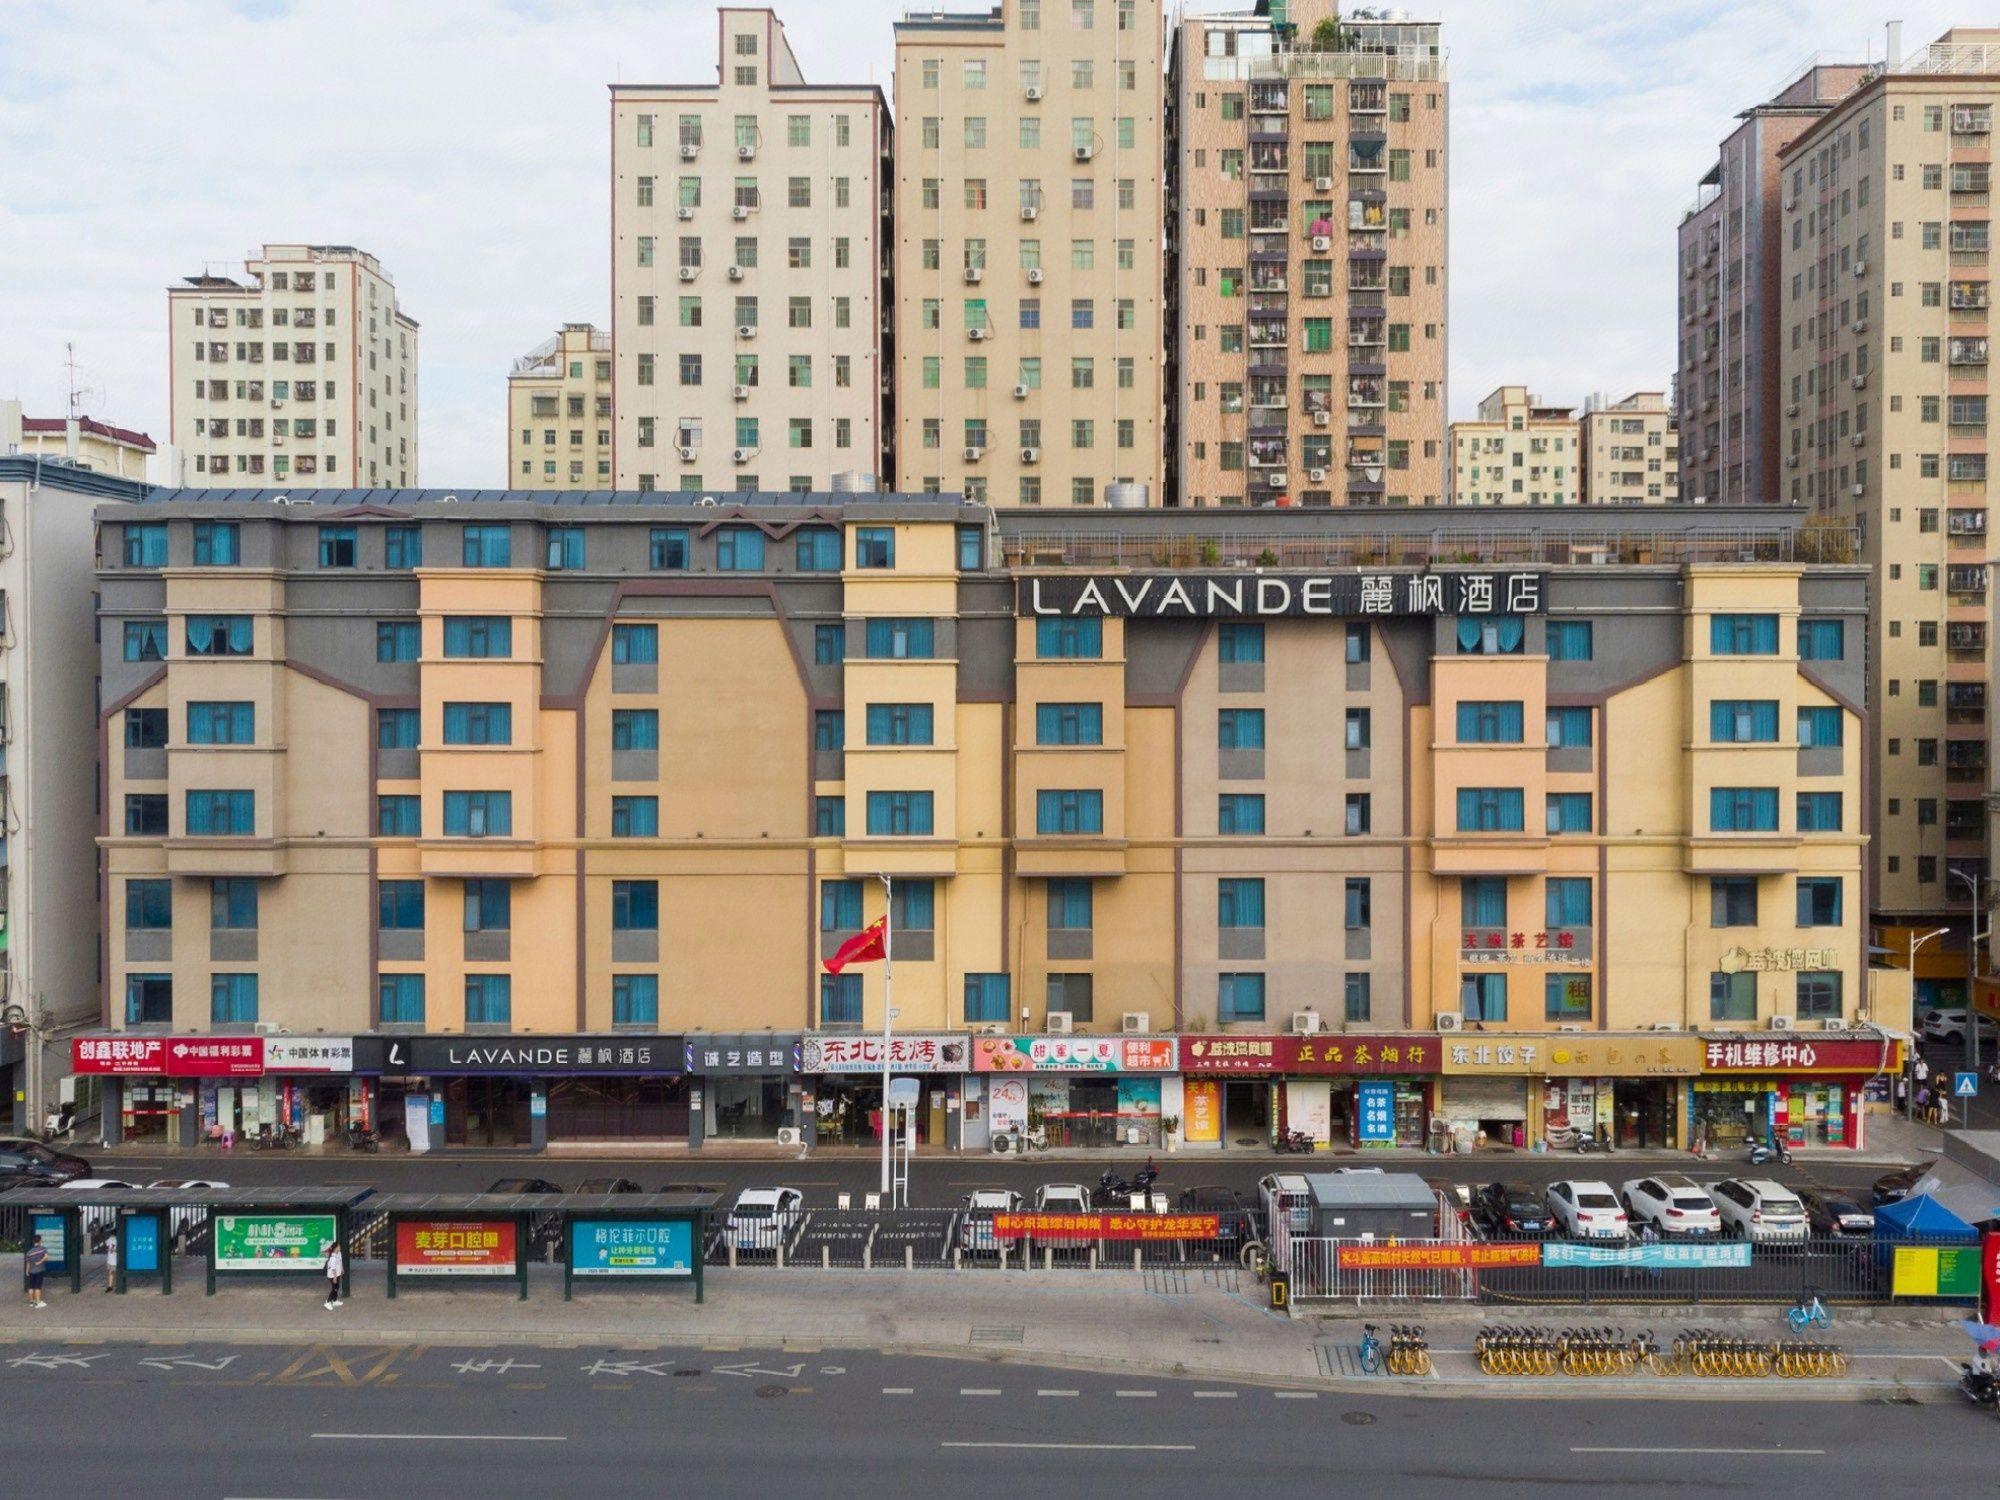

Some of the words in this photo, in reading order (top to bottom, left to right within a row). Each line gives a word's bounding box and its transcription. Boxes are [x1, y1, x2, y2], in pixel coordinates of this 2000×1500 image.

[1033, 578, 1332, 614] LAVANDE
[1360, 575, 1539, 613] 麗枫酒店
[78, 1040, 161, 1060] 创鑫联地产
[189, 1044, 252, 1058] 中国福利彩票
[289, 1046, 351, 1060] 中国体育彩票
[450, 1049, 568, 1065] LAVANDE
[577, 1048, 651, 1064] 麗枫酒店
[823, 1040, 937, 1063] 东北烧烤
[1033, 1043, 1110, 1058] 甜蜜一夏
[1126, 1042, 1151, 1054] 便利
[1297, 1046, 1425, 1065] 正品茶烟行
[1451, 1045, 1537, 1065] 东北饺子
[1707, 1042, 1816, 1067] 手机维修中心
[704, 1051, 784, 1067] 诚艺造型
[1126, 1054, 1151, 1067] 超市
